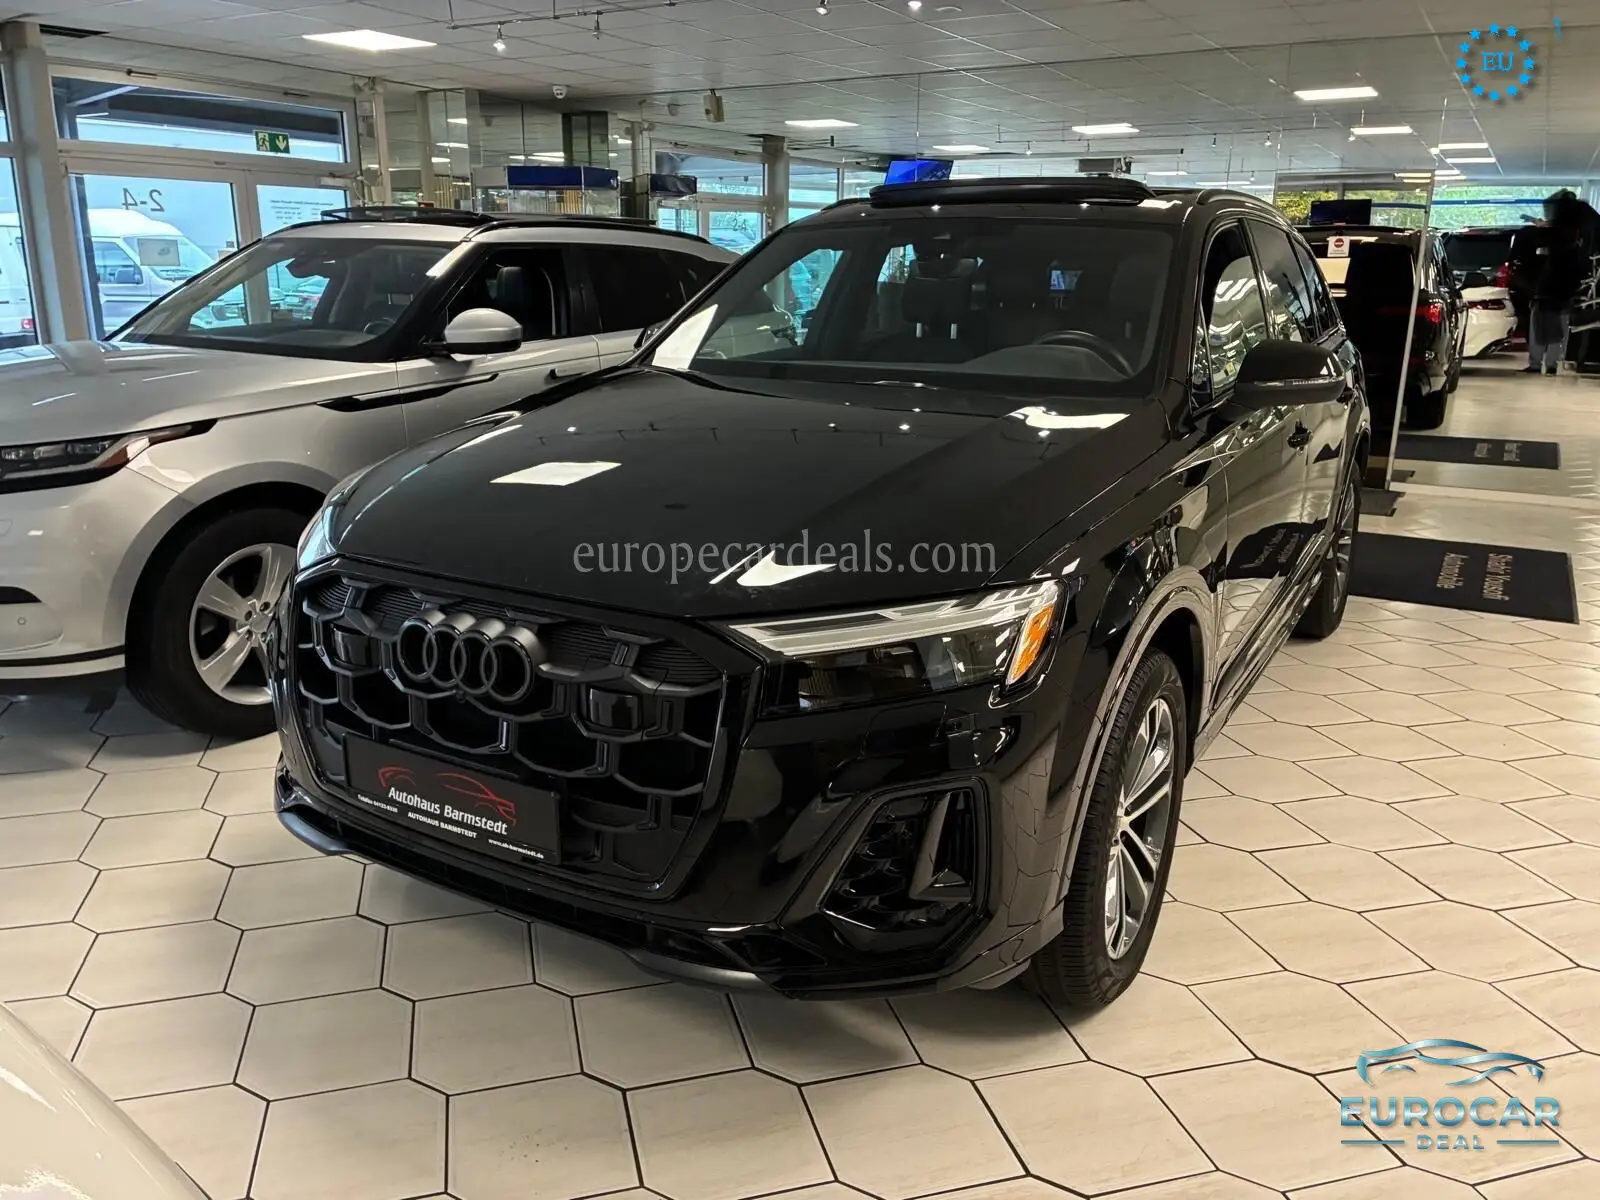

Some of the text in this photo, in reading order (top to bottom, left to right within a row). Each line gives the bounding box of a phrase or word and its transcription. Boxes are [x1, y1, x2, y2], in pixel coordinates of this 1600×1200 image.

[388, 786, 508, 835] Autohaus Barmstedt
[407, 811, 478, 839] AUTOHAUS BARMSTEDT
